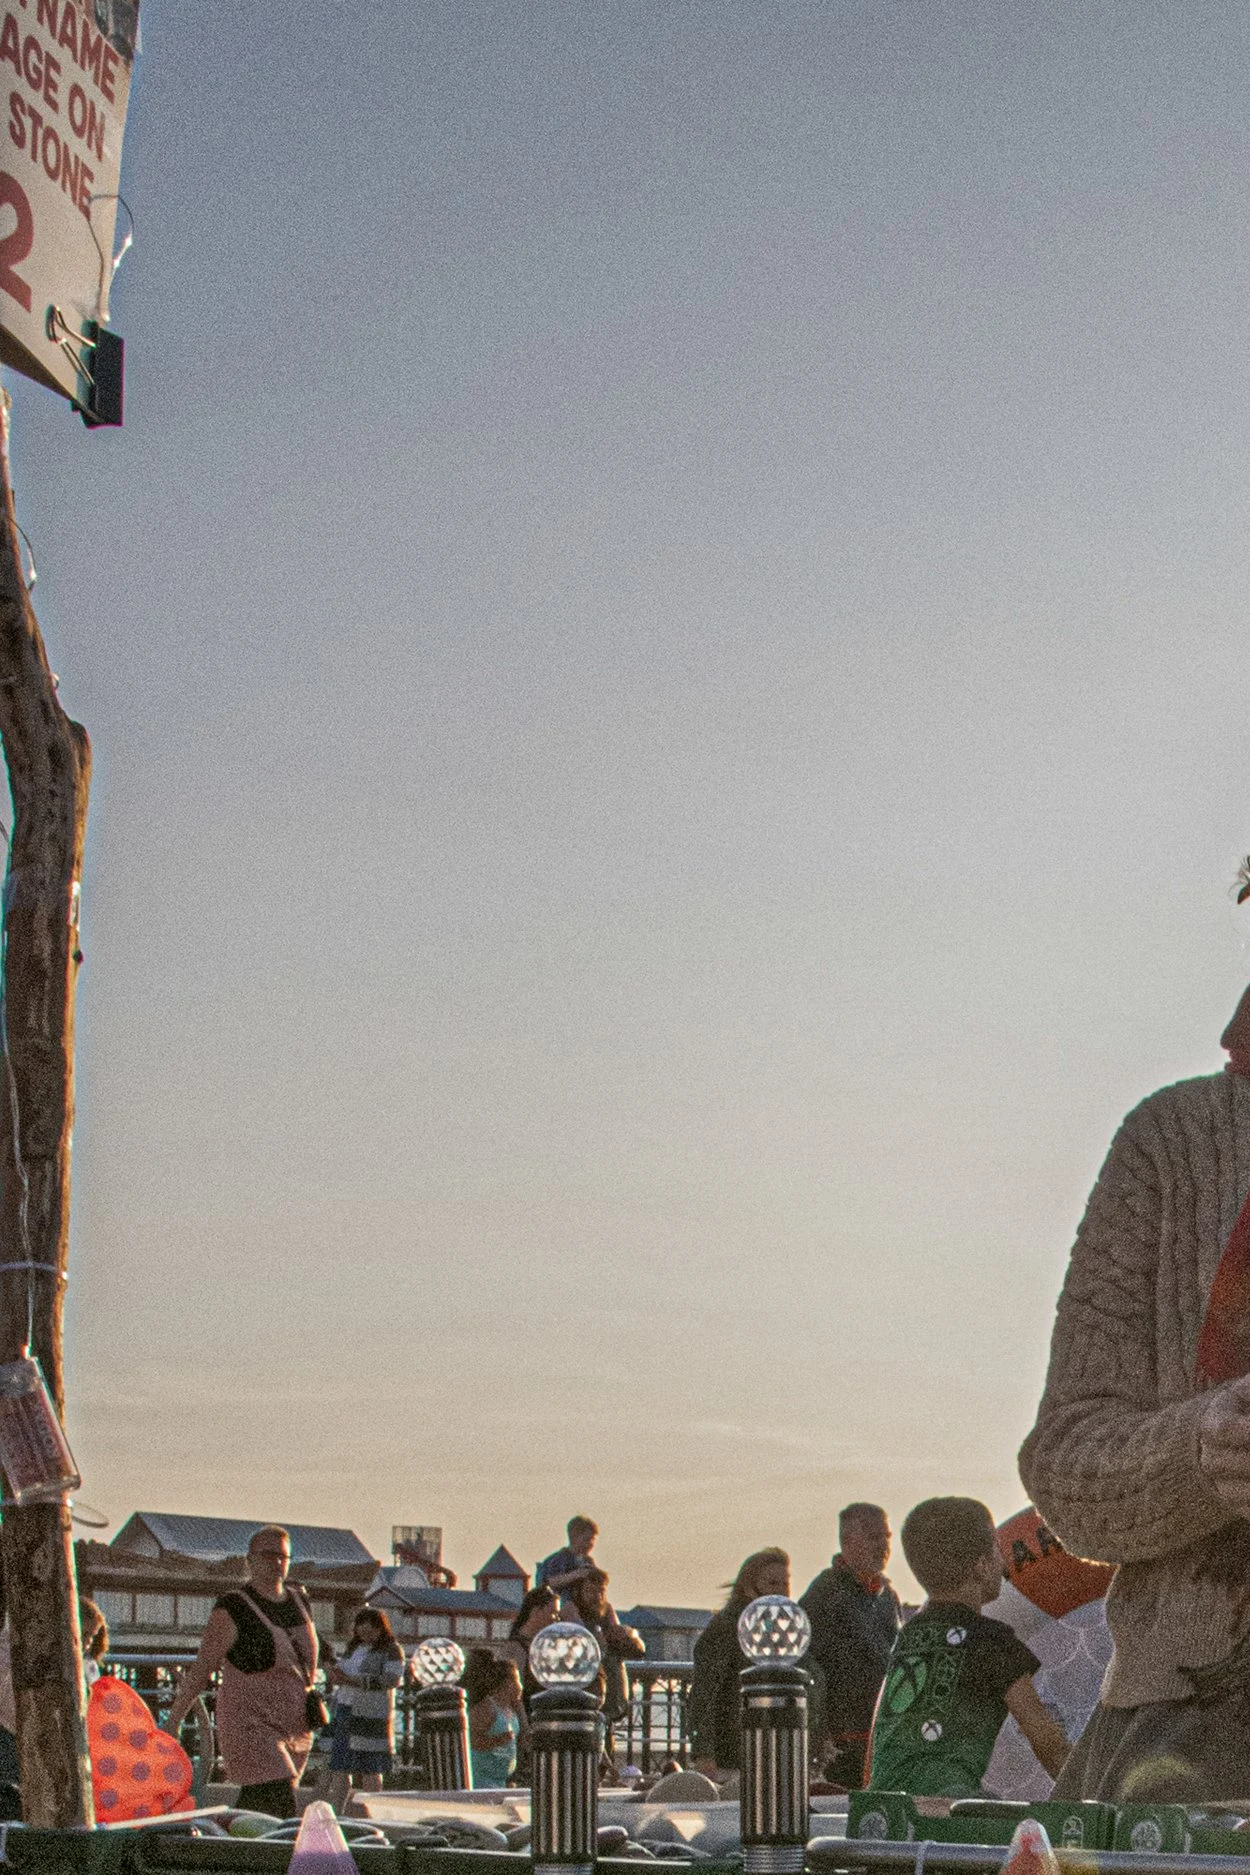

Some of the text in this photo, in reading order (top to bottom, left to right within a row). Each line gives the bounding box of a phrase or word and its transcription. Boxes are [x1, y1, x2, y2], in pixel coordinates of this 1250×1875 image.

[0, 12, 105, 162] AGE ON
[37, 0, 119, 105] NAME
[9, 91, 94, 222] STONE
